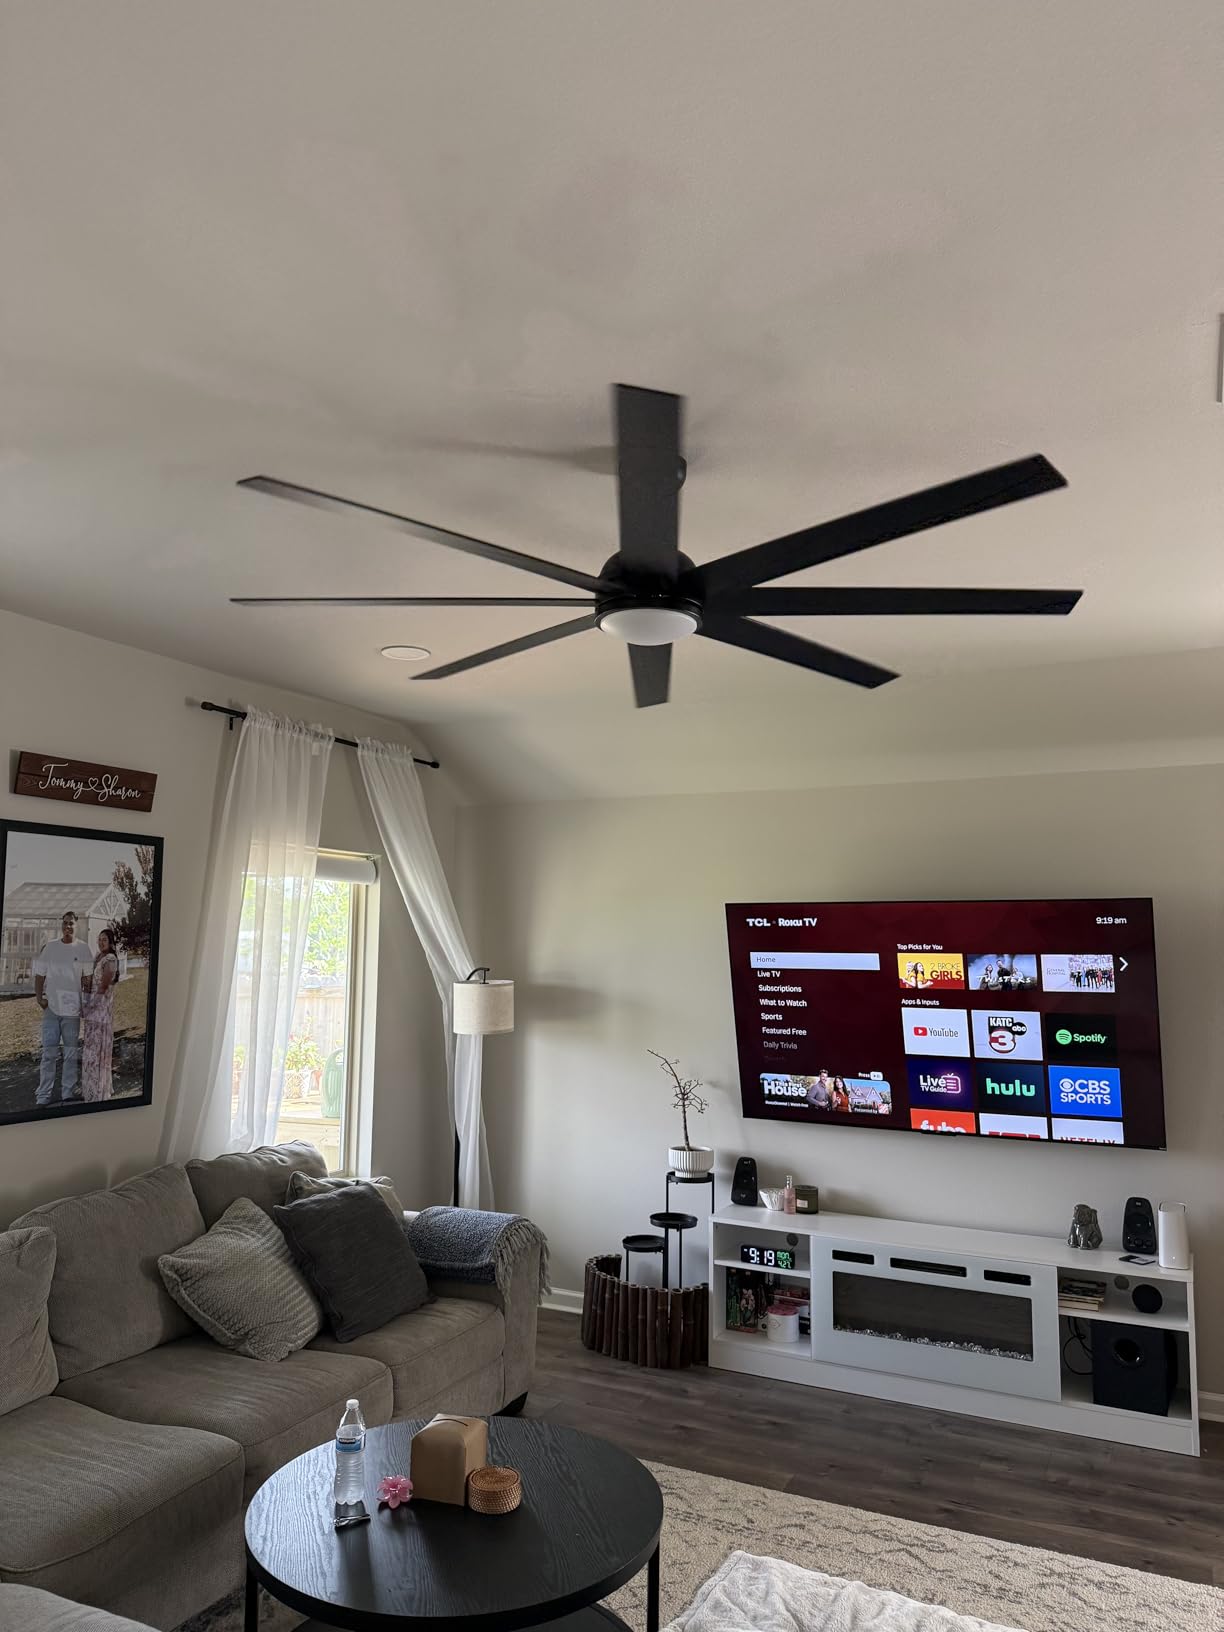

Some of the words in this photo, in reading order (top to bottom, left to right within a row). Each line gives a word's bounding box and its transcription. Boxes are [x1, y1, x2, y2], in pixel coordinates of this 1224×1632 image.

[38, 763, 83, 799] Tommy
[98, 773, 141, 801] Sharon
[746, 918, 771, 927] TCL
[778, 917, 803, 927] Roku
[803, 917, 818, 927] TV
[1095, 916, 1113, 924] 9:19
[757, 969, 771, 977] Live
[771, 970, 781, 978] TV
[930, 970, 963, 980] GIRLS
[758, 984, 802, 993] Subscriptions
[759, 998, 777, 1006] What
[786, 999, 807, 1007] Watch
[761, 1012, 783, 1020] Sports
[989, 1017, 1013, 1027] KATC
[762, 1026, 791, 1035] Featured
[791, 1028, 807, 1036] Free
[929, 1027, 959, 1038] YouTube
[989, 1029, 1016, 1053] 3
[1073, 1033, 1106, 1044] Spotify
[763, 1041, 779, 1050] Daily
[780, 1041, 798, 1050] Trivia
[919, 1075, 946, 1086] Live
[763, 1080, 807, 1098] House
[985, 1078, 1035, 1096] hulu
[1074, 1079, 1111, 1094] CBS
[1060, 1092, 1112, 1105] SPORTS
[749, 1247, 775, 1266] 9:19
